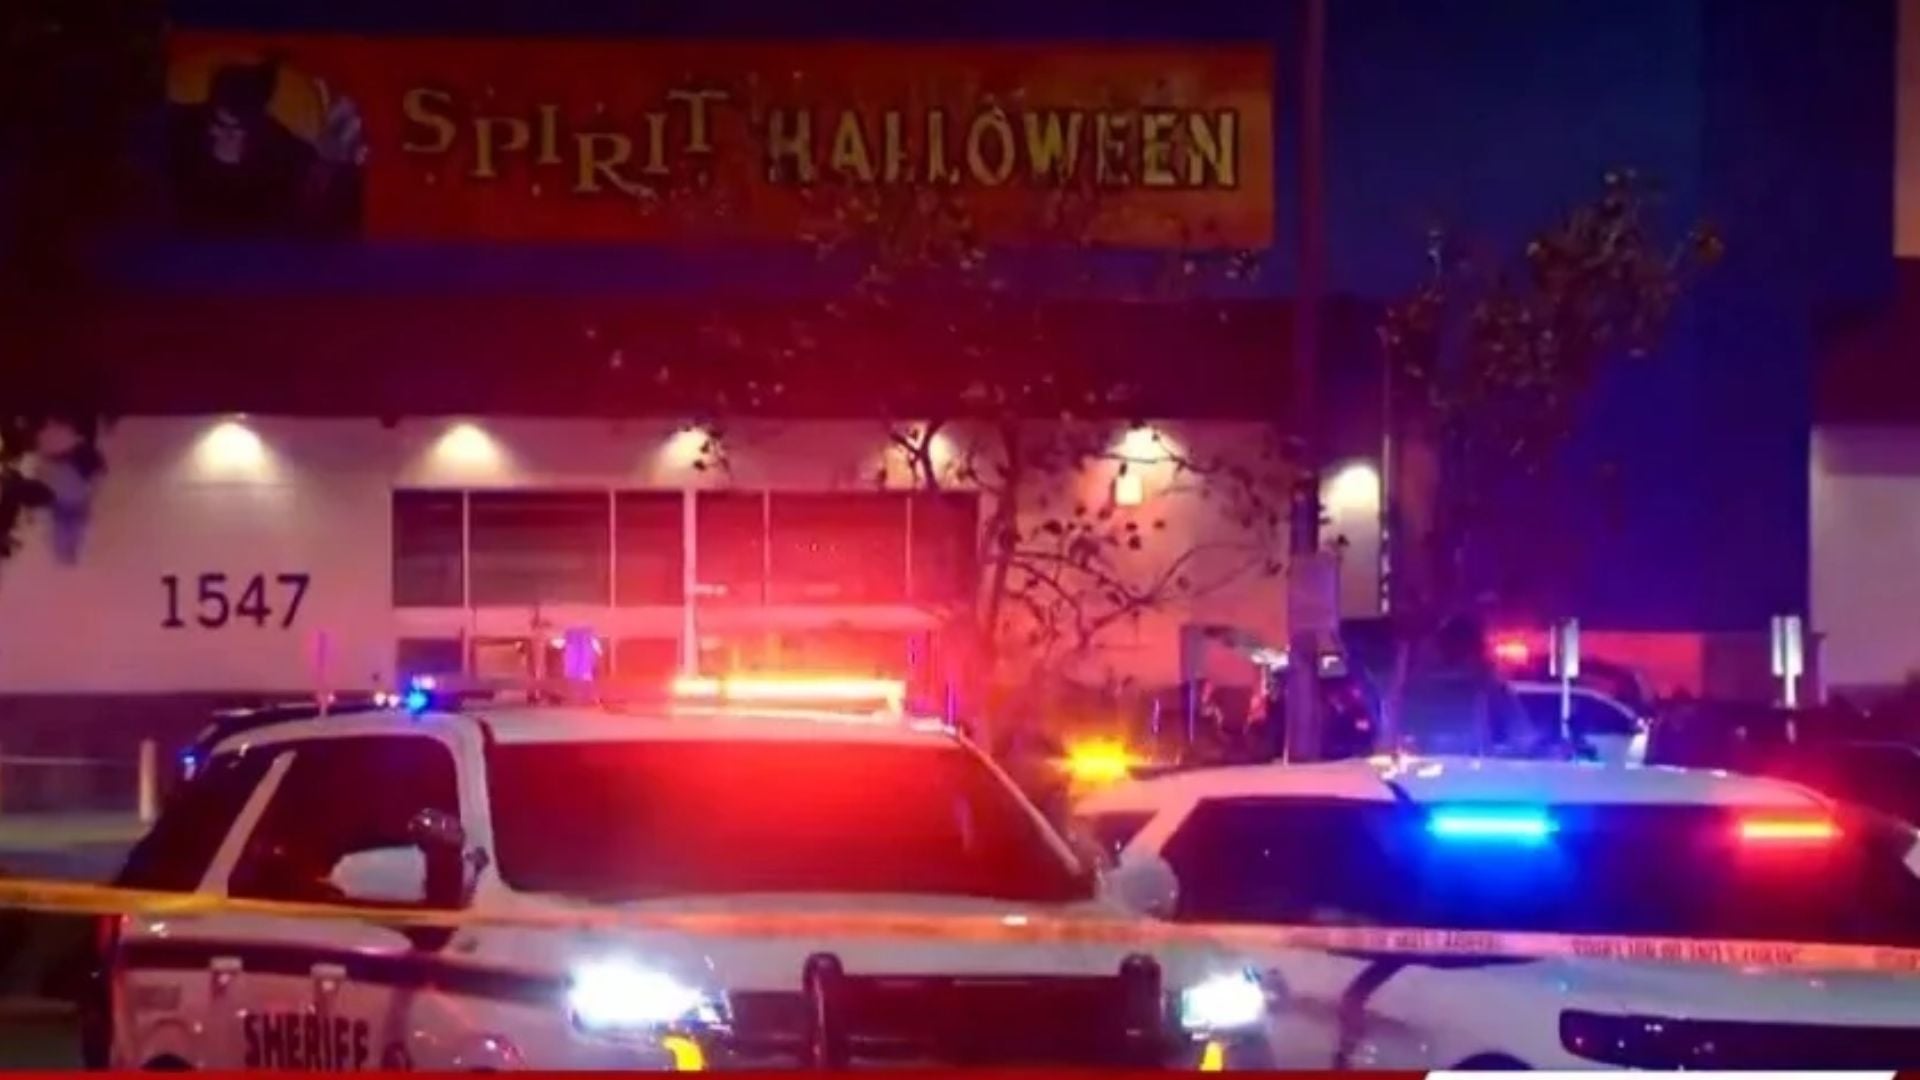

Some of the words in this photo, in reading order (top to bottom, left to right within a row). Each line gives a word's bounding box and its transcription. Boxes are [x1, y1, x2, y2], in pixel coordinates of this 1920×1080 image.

[403, 88, 729, 200] SPIRIT
[765, 104, 1240, 189] HALLOWEEN
[160, 573, 311, 628] 1547
[243, 1013, 369, 1069] SHERIFF
